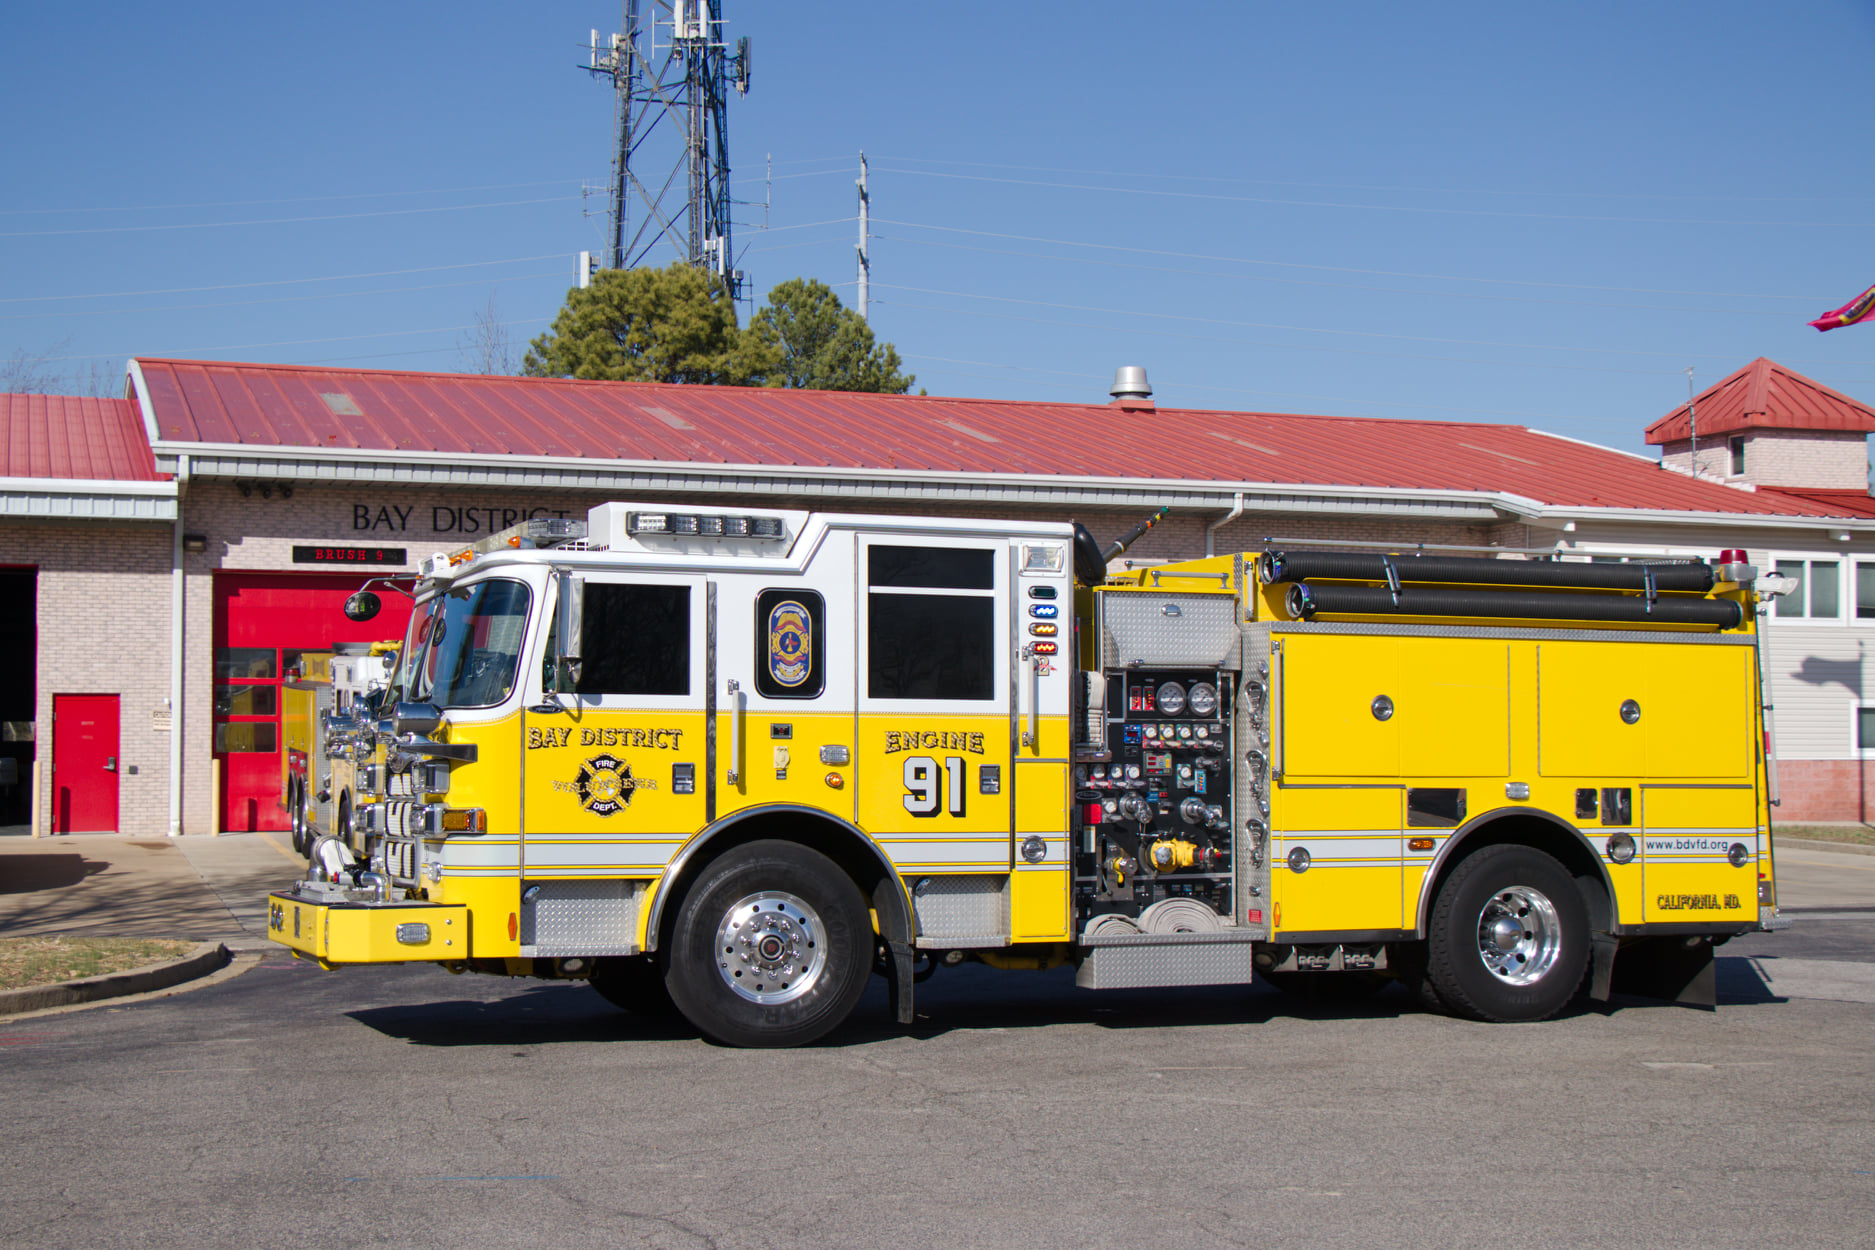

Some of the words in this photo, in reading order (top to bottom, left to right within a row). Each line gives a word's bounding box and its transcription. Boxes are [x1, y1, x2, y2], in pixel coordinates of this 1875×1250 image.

[352, 504, 414, 531] BAY
[315, 548, 367, 561] BRUSH
[376, 550, 384, 561] 9
[527, 727, 572, 750] BAY
[580, 727, 683, 751] DISTRICT
[884, 730, 985, 755] ENGINE
[595, 759, 616, 769] FIRE
[902, 755, 967, 818] 91
[592, 801, 618, 812] DEPT.
[1645, 838, 1729, 852] www.bdvfd.org
